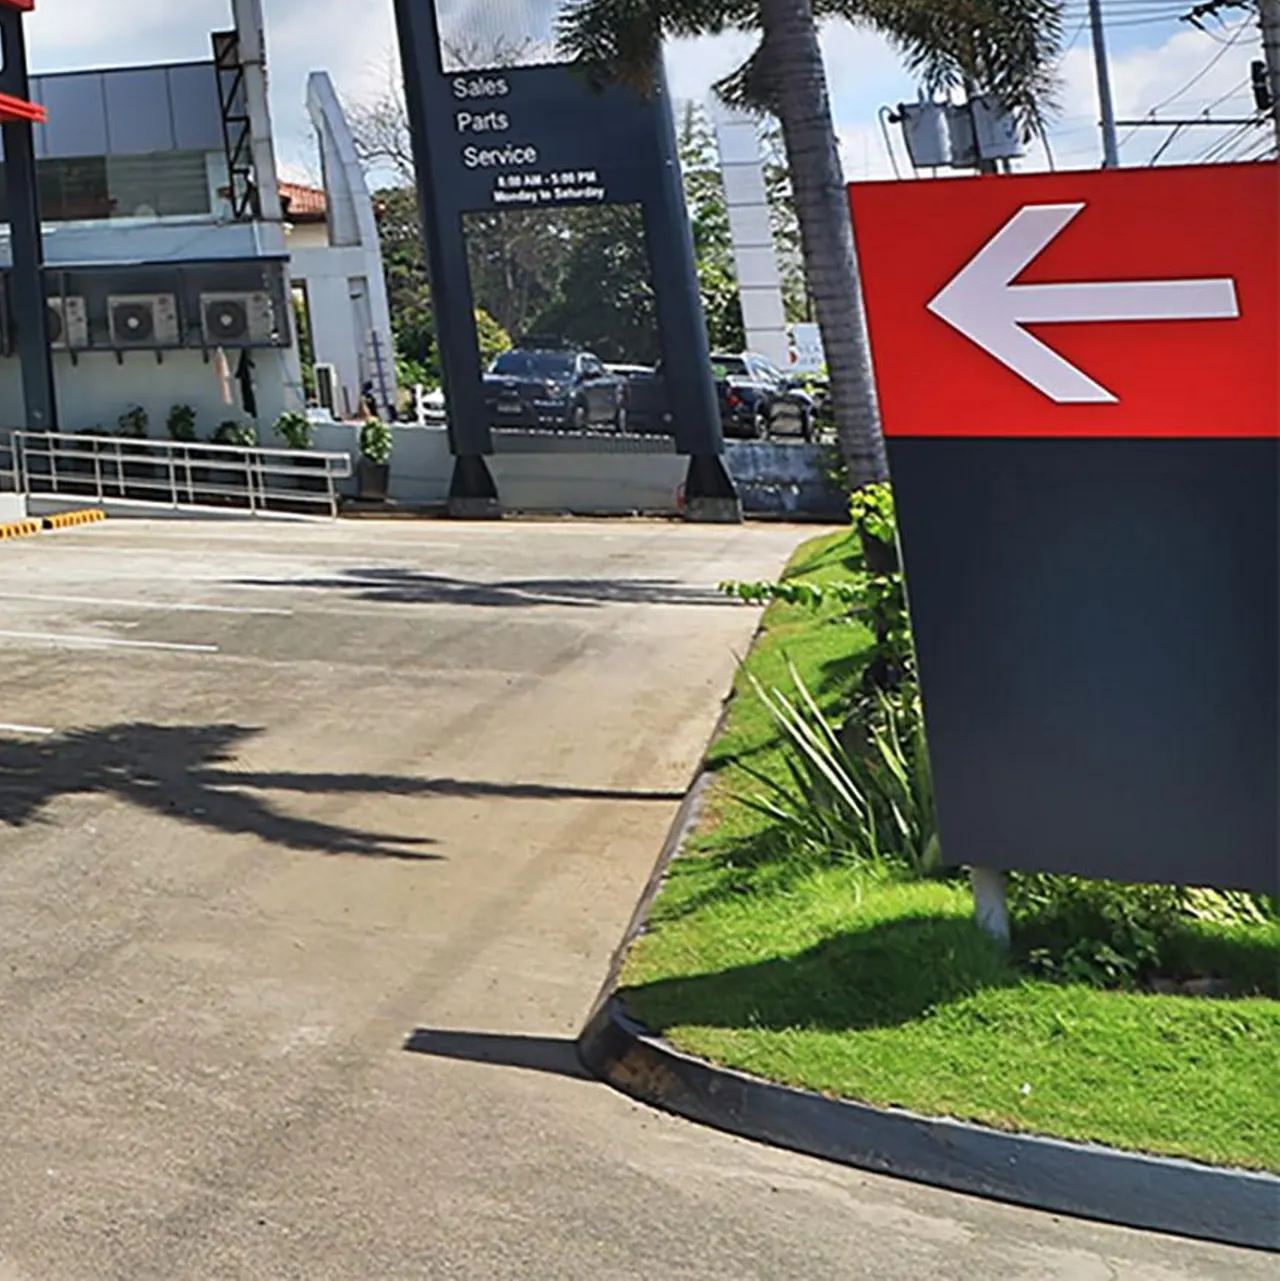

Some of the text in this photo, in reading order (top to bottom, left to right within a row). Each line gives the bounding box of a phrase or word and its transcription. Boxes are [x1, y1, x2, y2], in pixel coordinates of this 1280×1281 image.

[452, 77, 509, 98] Sales
[456, 111, 509, 132] Parts
[463, 144, 537, 167] Service
[524, 174, 542, 186] AM
[577, 170, 597, 183] PM
[493, 186, 605, 203] Monday to Saturday
